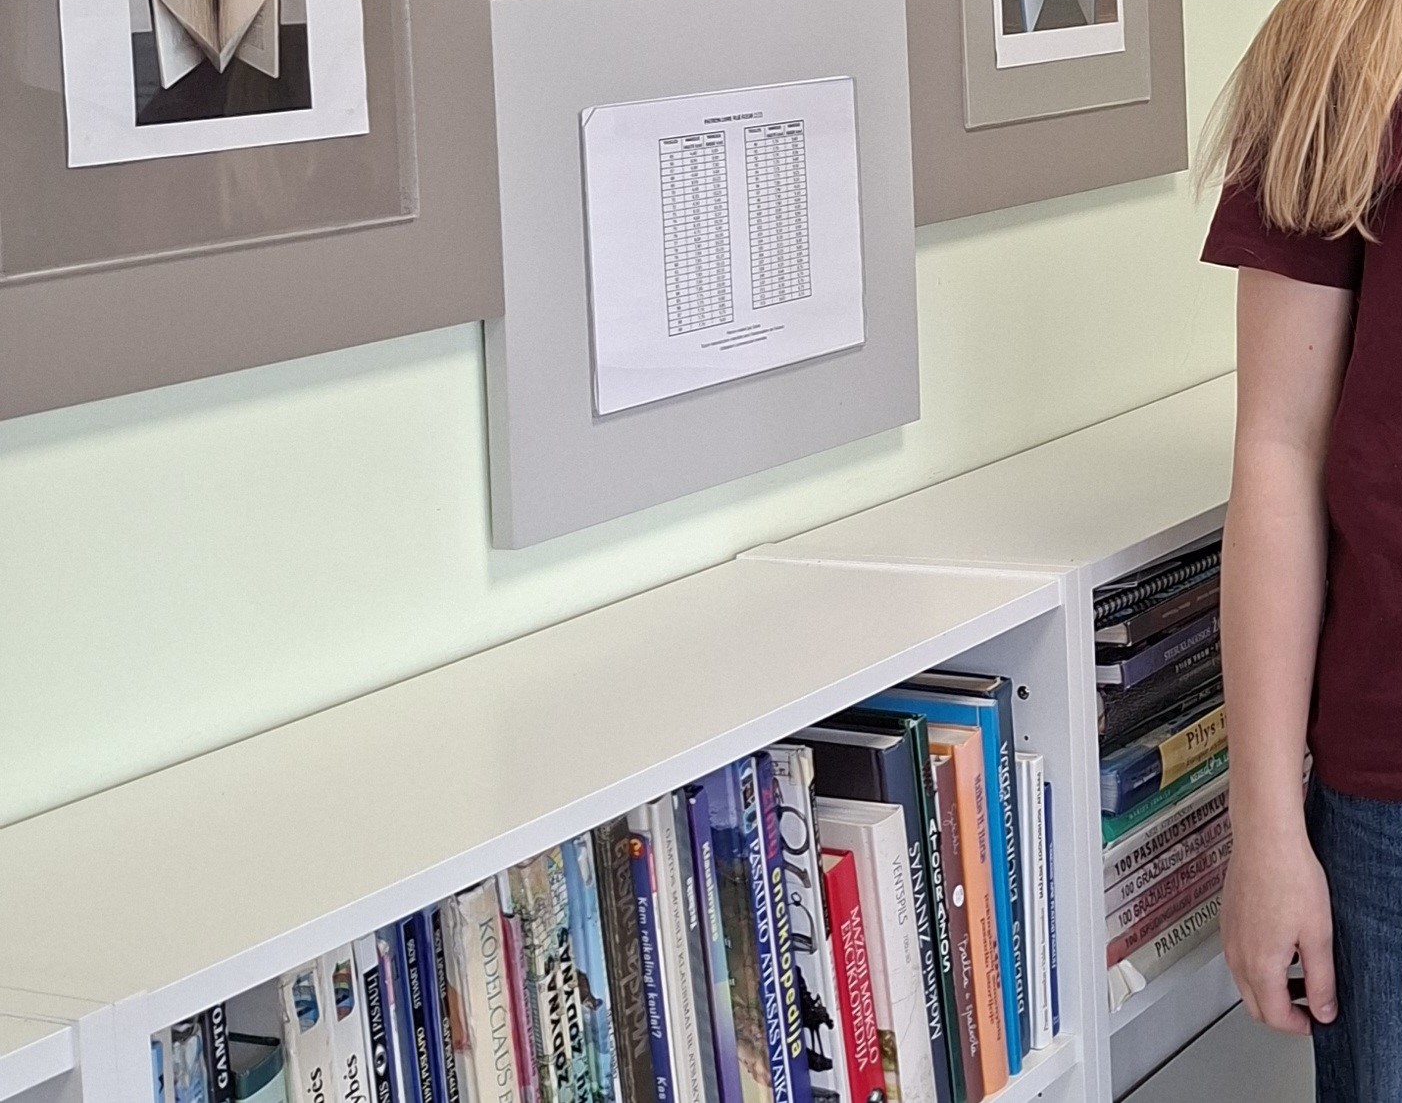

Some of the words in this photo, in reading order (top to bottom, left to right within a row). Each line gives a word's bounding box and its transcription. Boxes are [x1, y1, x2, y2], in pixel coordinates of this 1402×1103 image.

[1186, 722, 1216, 750] Pilys
[1114, 857, 1132, 876] 100
[1133, 826, 1179, 865] PASAULIO
[637, 896, 647, 926] Kam
[892, 854, 908, 926] VENTSPILS
[1118, 910, 1132, 929] 100
[1121, 881, 1135, 900] 100
[750, 838, 768, 944] PASAULIO
[760, 953, 781, 1051] ATLASAS
[771, 1050, 788, 1103] VAIK
[772, 866, 801, 1058] enciklopedija
[850, 904, 869, 978] MAŽOJI
[860, 980, 879, 1065] MOKSLO
[619, 937, 649, 1059] Mokslas
[841, 919, 867, 1072] ENCIKLOPEDIJA
[924, 948, 942, 1041] Mokinio
[343, 1053, 367, 1103] ybės
[378, 1081, 392, 1103] NIS
